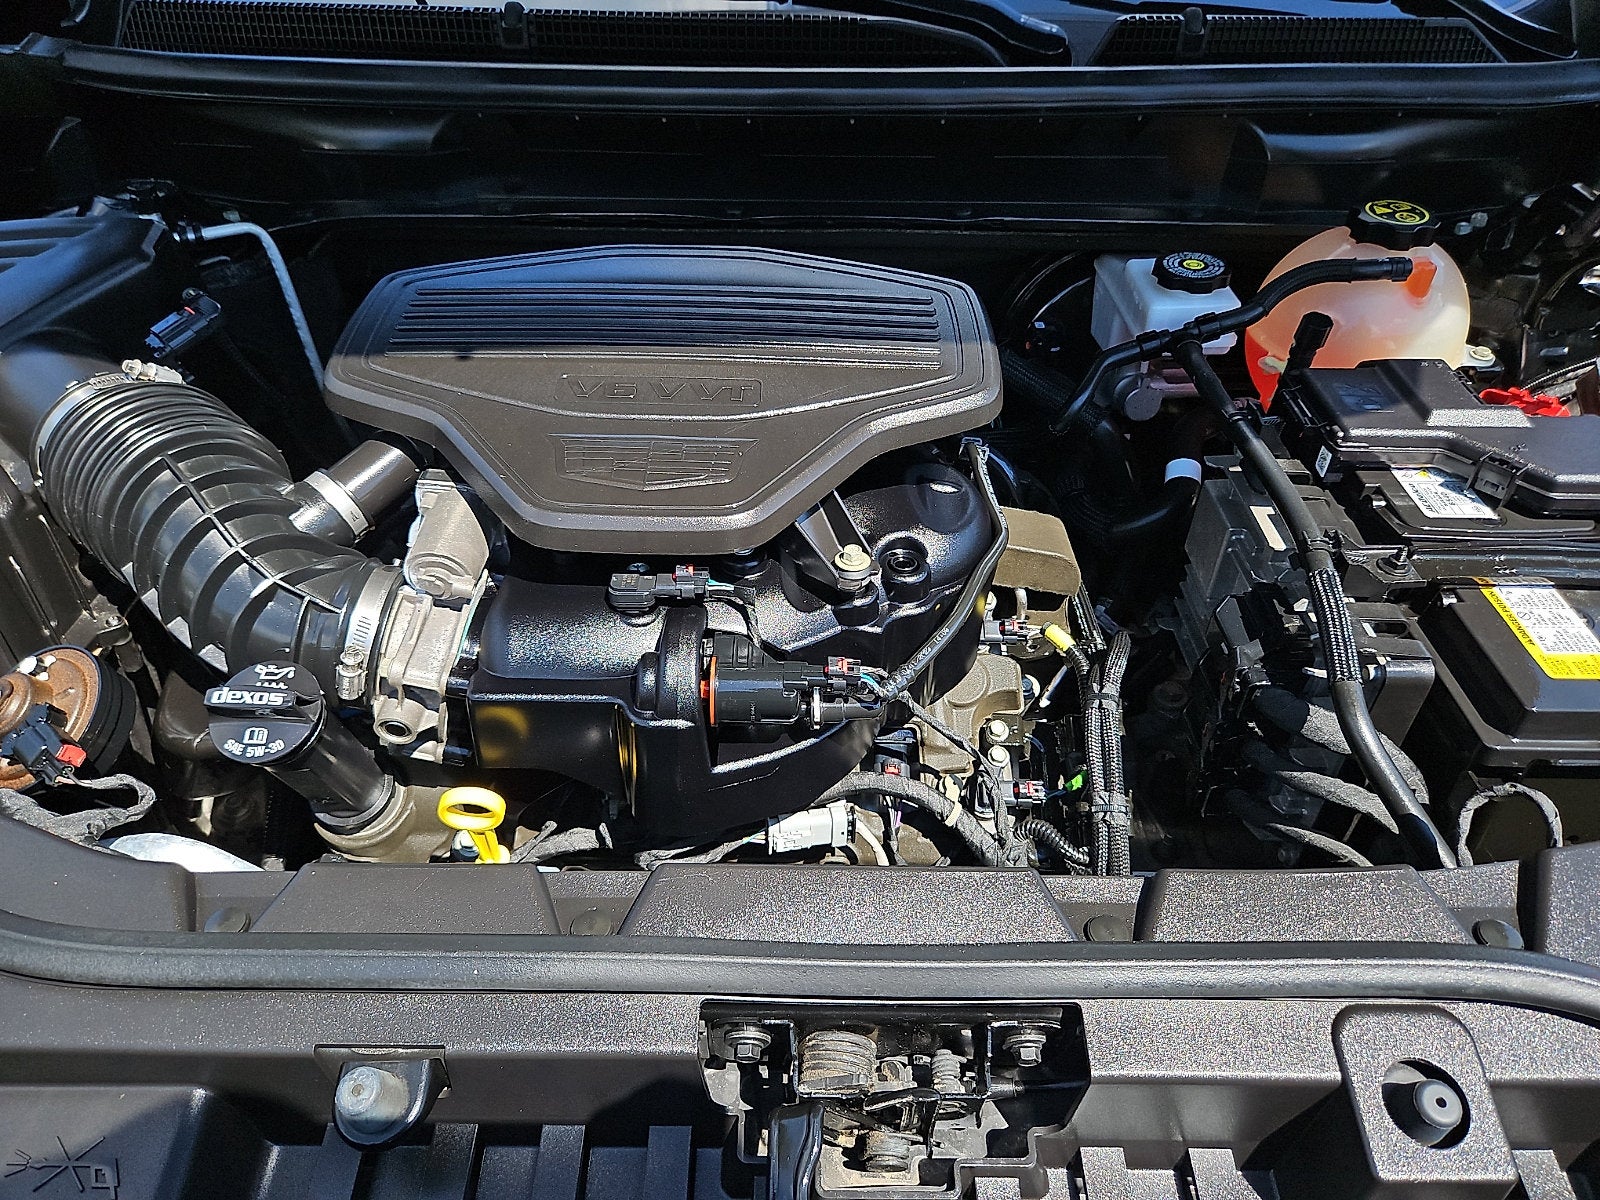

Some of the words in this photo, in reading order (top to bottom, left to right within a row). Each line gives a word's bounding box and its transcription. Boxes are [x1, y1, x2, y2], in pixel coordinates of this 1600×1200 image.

[566, 379, 638, 399] V6
[648, 380, 755, 402] VVT
[211, 686, 288, 706] dexos
[223, 739, 246, 756] SAE
[245, 739, 286, 758] 5W-30
